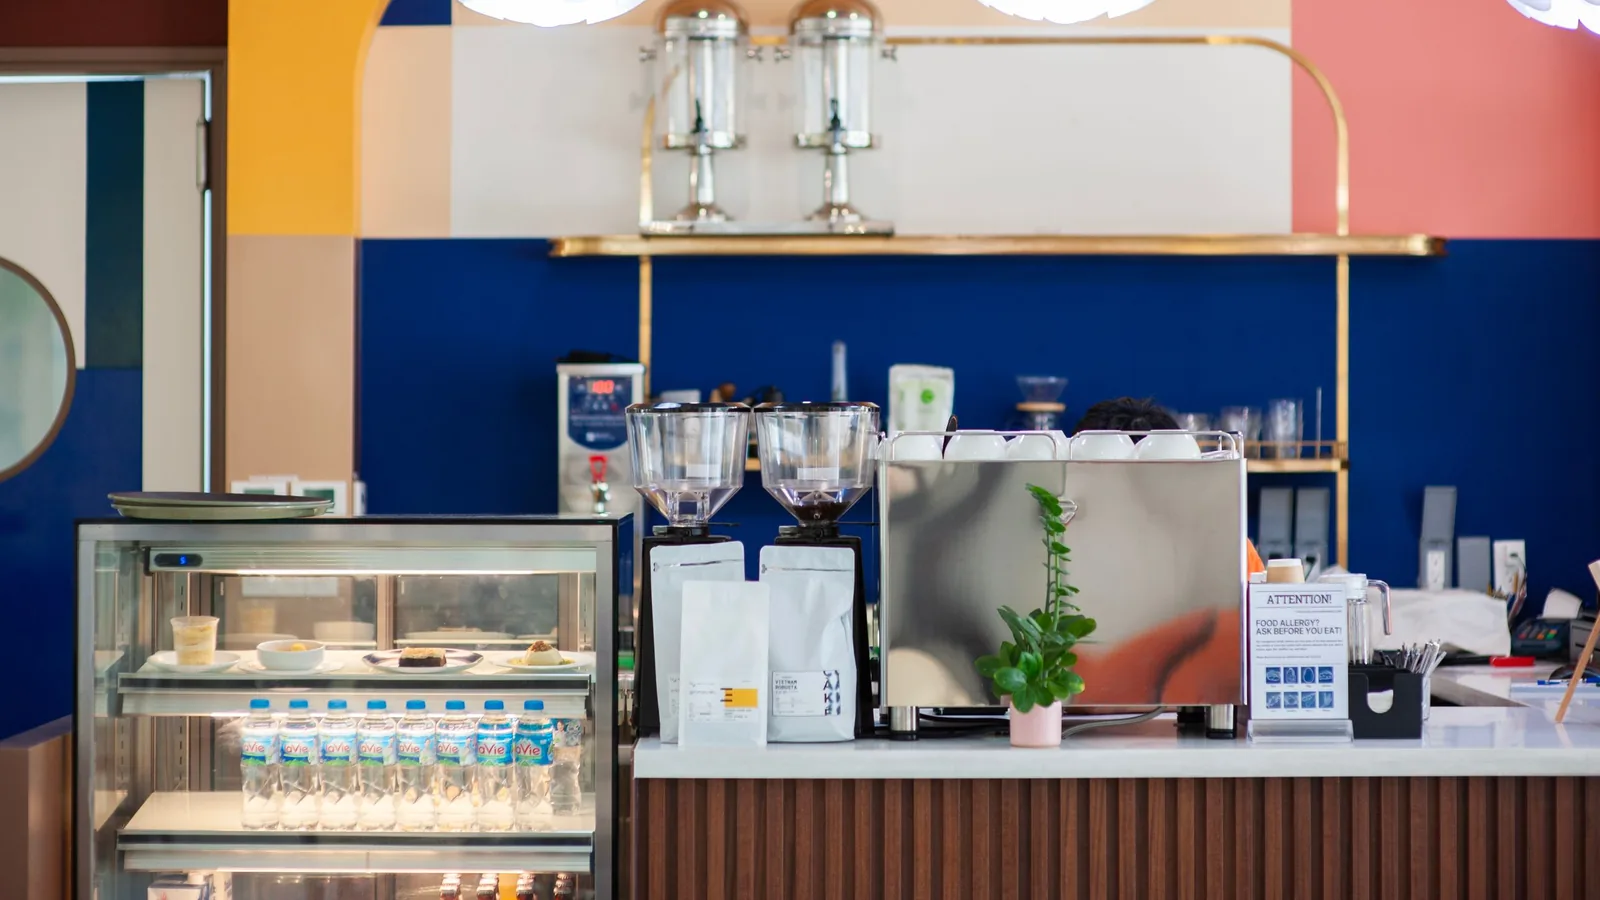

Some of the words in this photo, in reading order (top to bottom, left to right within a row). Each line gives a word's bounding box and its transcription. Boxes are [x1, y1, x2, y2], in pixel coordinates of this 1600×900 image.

[1267, 594, 1332, 605] ATTENTION!
[1256, 619, 1279, 627] FOOD
[1280, 619, 1320, 627] ALLERGY?
[1256, 627, 1272, 635] ASK
[1273, 627, 1304, 635] BEFORE
[1305, 627, 1323, 635] YOU
[1324, 627, 1342, 635] EAT!
